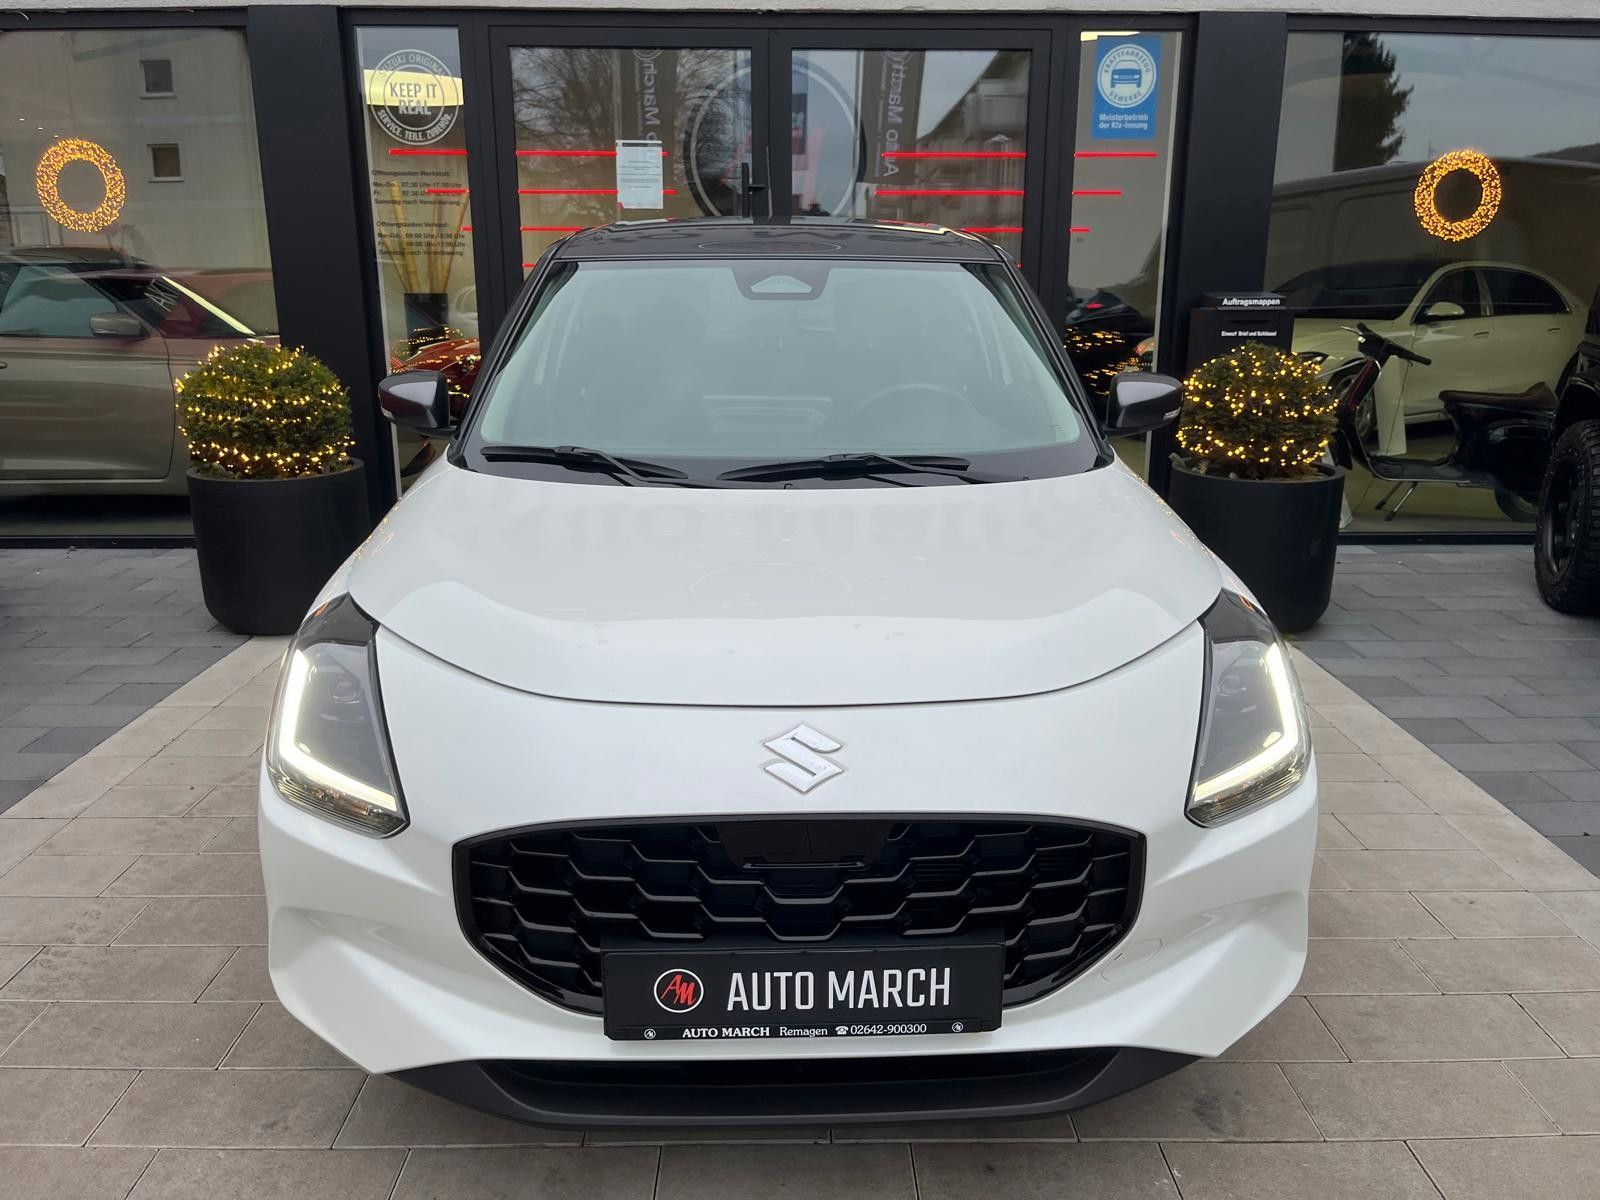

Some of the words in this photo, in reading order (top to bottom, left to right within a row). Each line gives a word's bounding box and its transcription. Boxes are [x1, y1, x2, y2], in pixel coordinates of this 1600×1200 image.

[390, 82, 421, 98] KEEP
[426, 82, 438, 98] IT
[398, 99, 432, 115] REAL
[1222, 297, 1281, 307] Auftragsmappen
[727, 971, 815, 1011] AUTO
[828, 967, 951, 1009] MARCH
[682, 1027, 718, 1038] AUTO
[722, 1026, 770, 1037] MARCH
[779, 1026, 828, 1037] Remagen
[850, 1023, 927, 1035] 02642-900300
